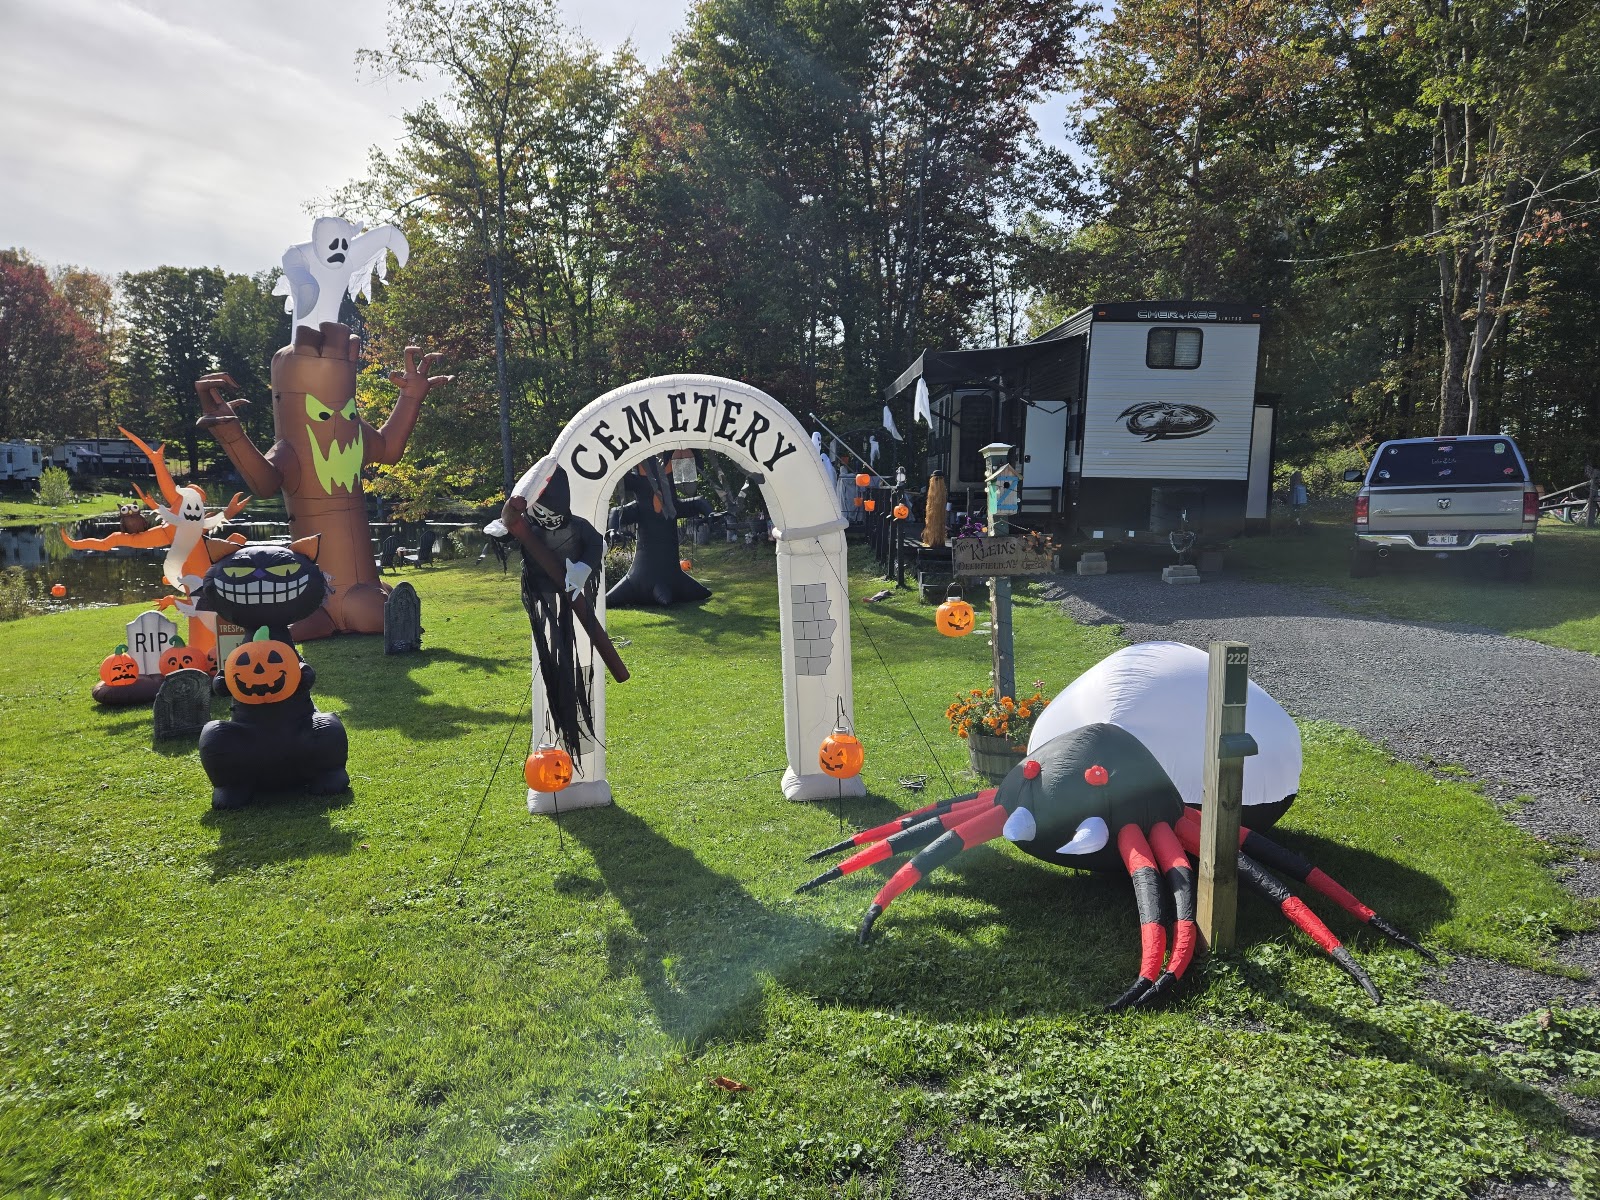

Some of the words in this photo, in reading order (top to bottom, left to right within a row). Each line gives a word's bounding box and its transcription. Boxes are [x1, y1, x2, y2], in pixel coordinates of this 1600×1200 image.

[570, 392, 797, 480] CEMETERY
[219, 624, 246, 633] TRESPA
[135, 632, 168, 653] RIP
[1227, 653, 1247, 664] 222
